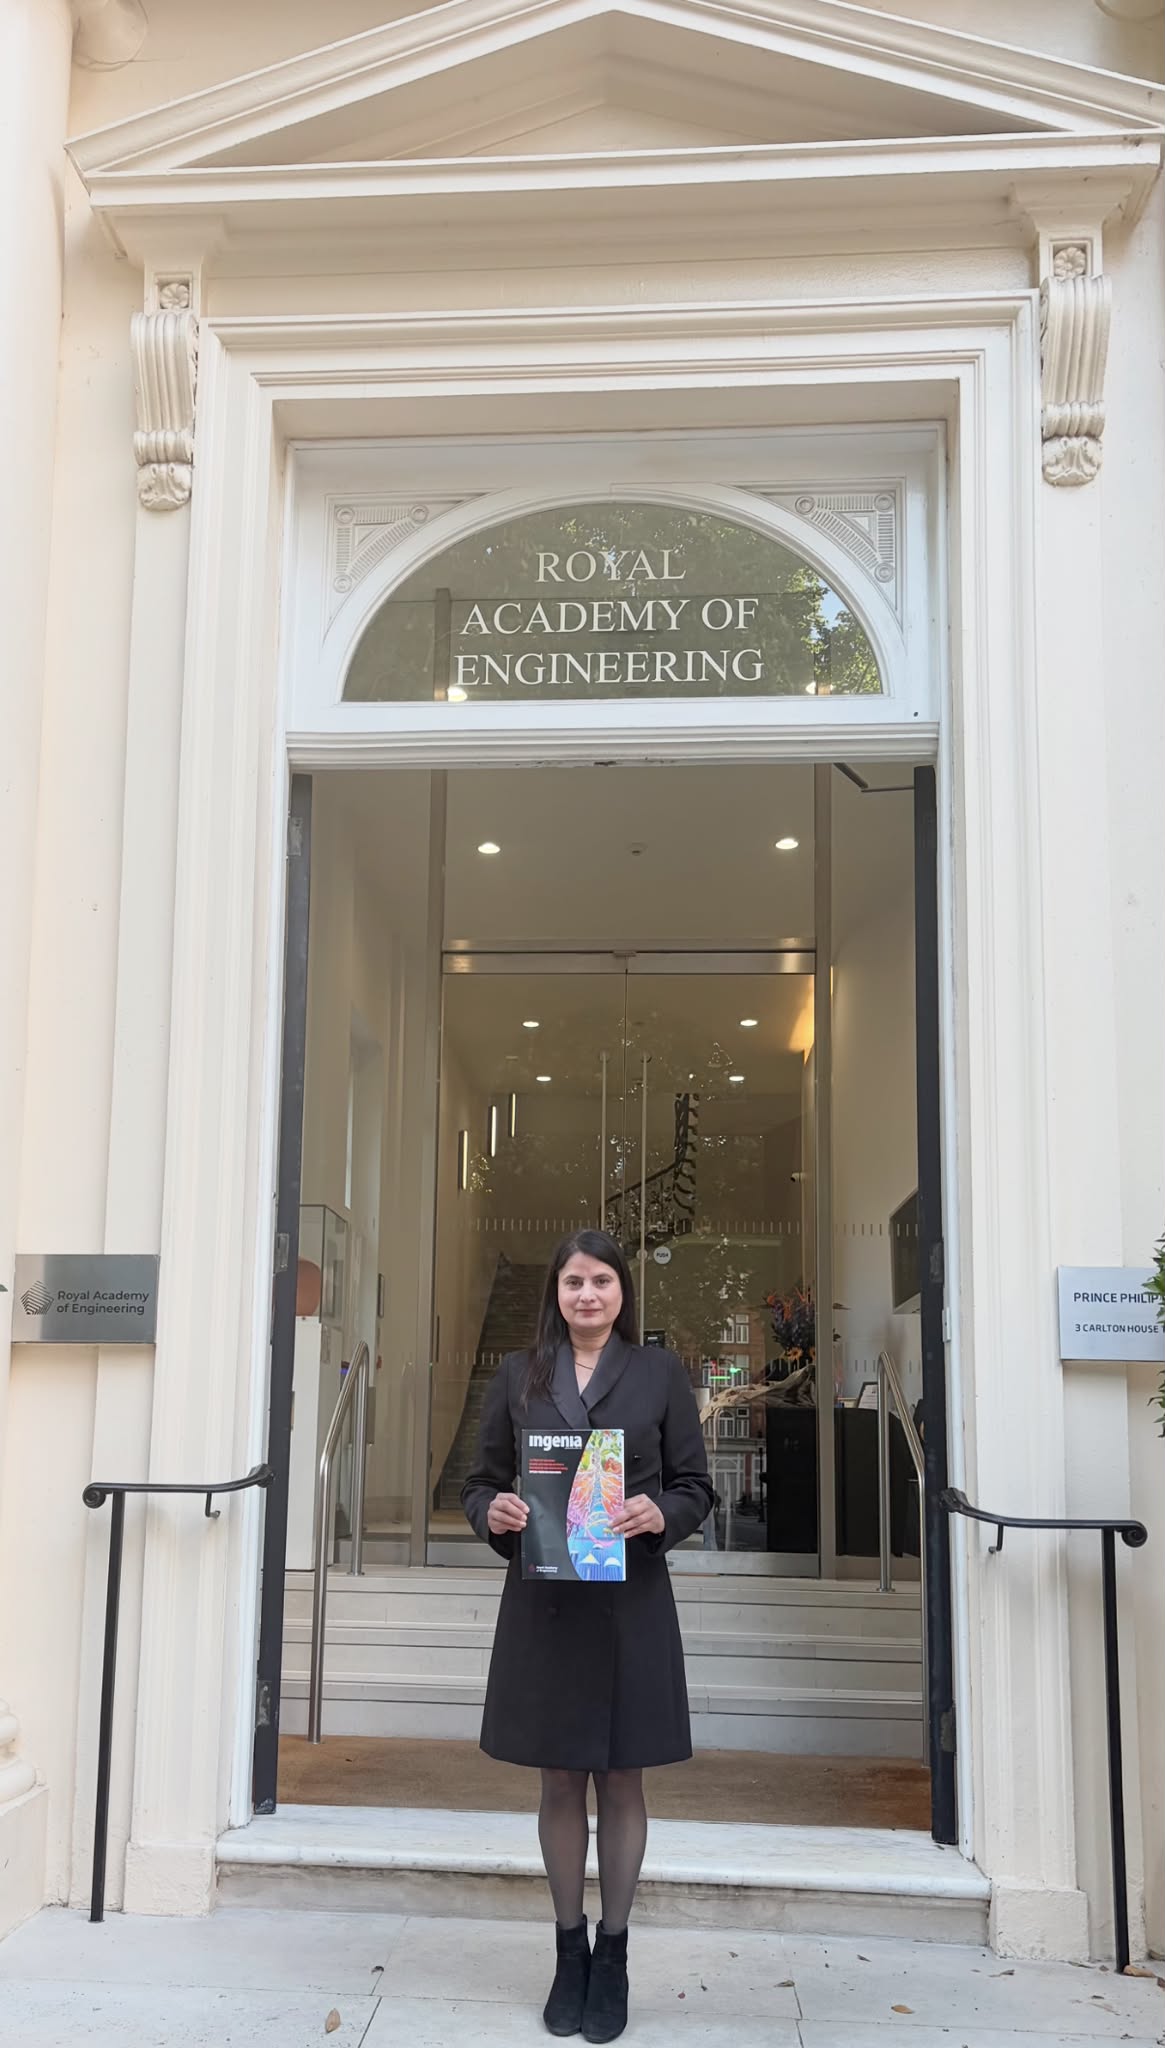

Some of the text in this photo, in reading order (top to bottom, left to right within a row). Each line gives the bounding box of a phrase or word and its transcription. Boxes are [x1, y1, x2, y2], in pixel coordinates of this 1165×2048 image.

[535, 549, 686, 583] ROYAL
[461, 598, 759, 635] ACADEMY OF
[454, 649, 764, 687] ENGINEERING
[57, 1290, 149, 1302] Royal Academy
[1073, 1292, 1118, 1303] PRINCE
[1120, 1293, 1158, 1304] PHILIP
[56, 1303, 145, 1315] of Engineering
[1075, 1324, 1081, 1332] 3
[1082, 1324, 1126, 1333] CARLTON
[1127, 1325, 1159, 1333] HOUSE
